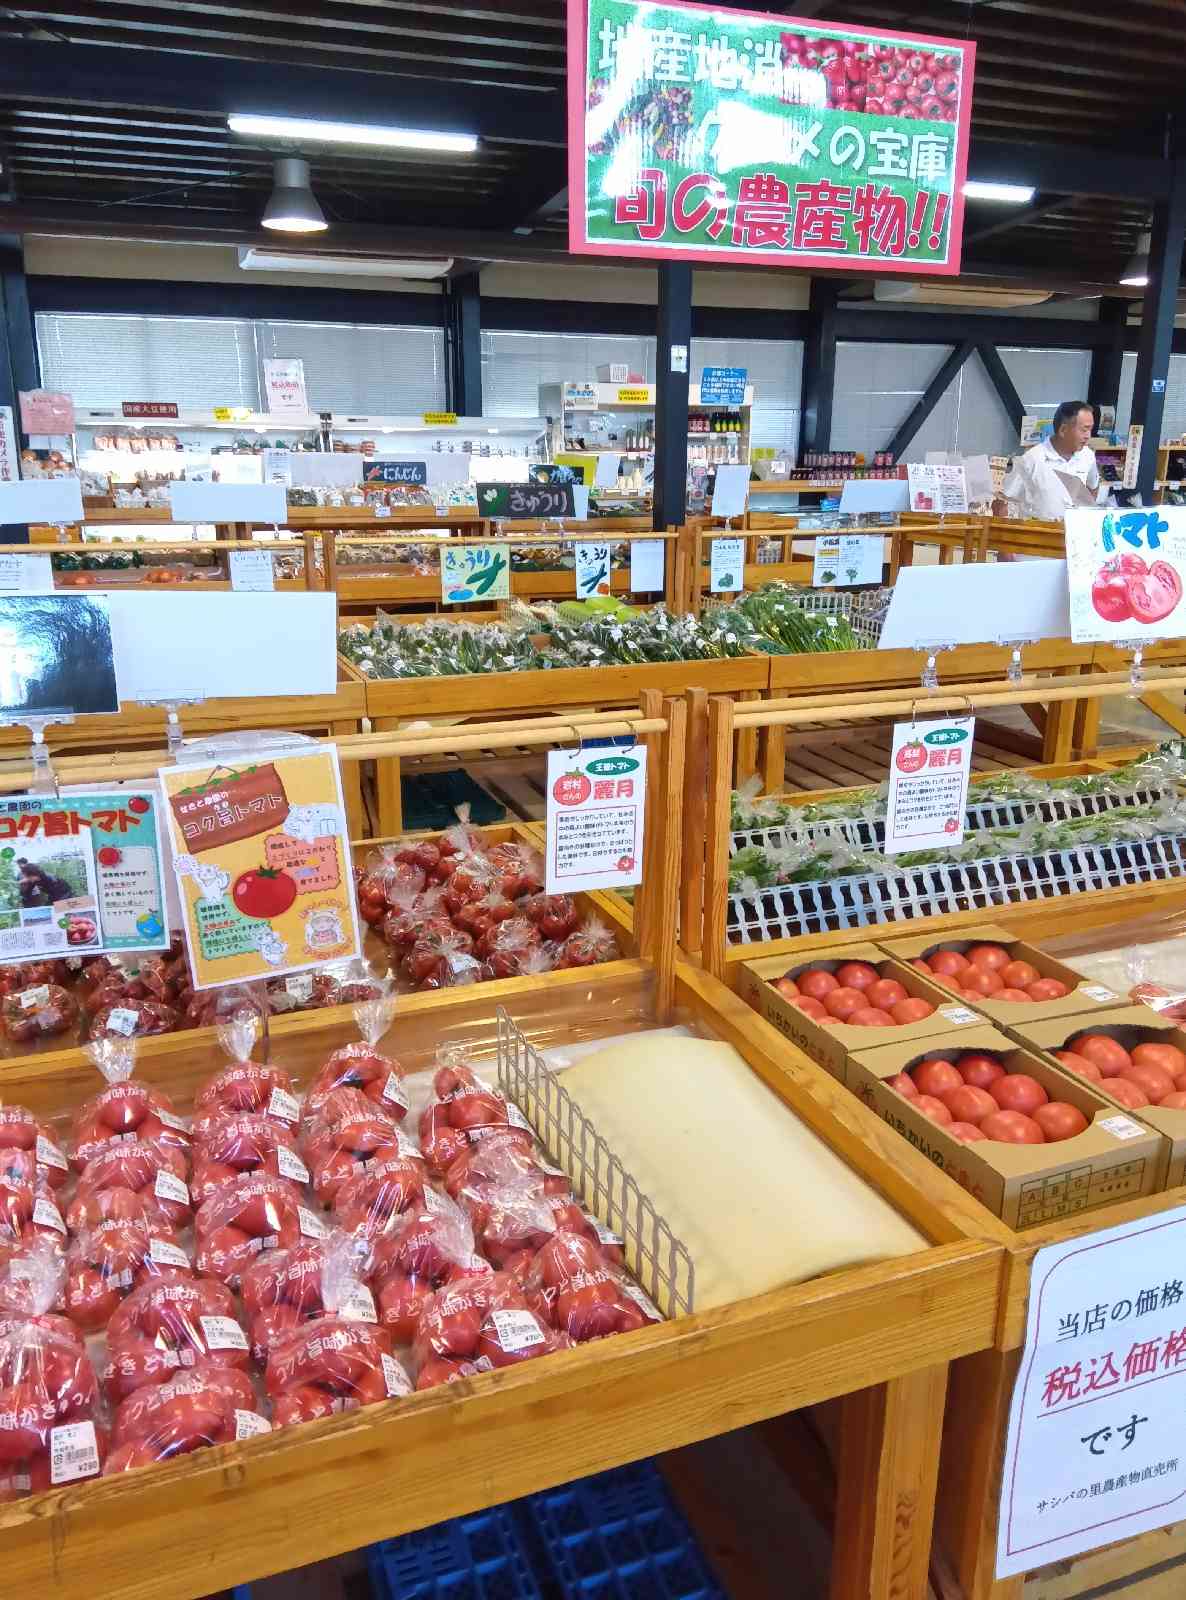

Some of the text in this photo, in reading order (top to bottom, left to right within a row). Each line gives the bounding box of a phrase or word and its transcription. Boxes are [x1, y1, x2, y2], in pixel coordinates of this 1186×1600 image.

[383, 465, 422, 482] にんじん
[510, 490, 568, 513] きゅうり
[1101, 511, 1169, 553] トマト
[0, 808, 141, 839] コク旨トマト
[184, 793, 283, 839] コク旨トマト
[1056, 1279, 1185, 1341] 当店の価格
[1040, 1325, 1186, 1408] 税込価格
[1080, 1414, 1149, 1455] です
[1036, 1457, 1179, 1514] サシバの里農産物直売所
